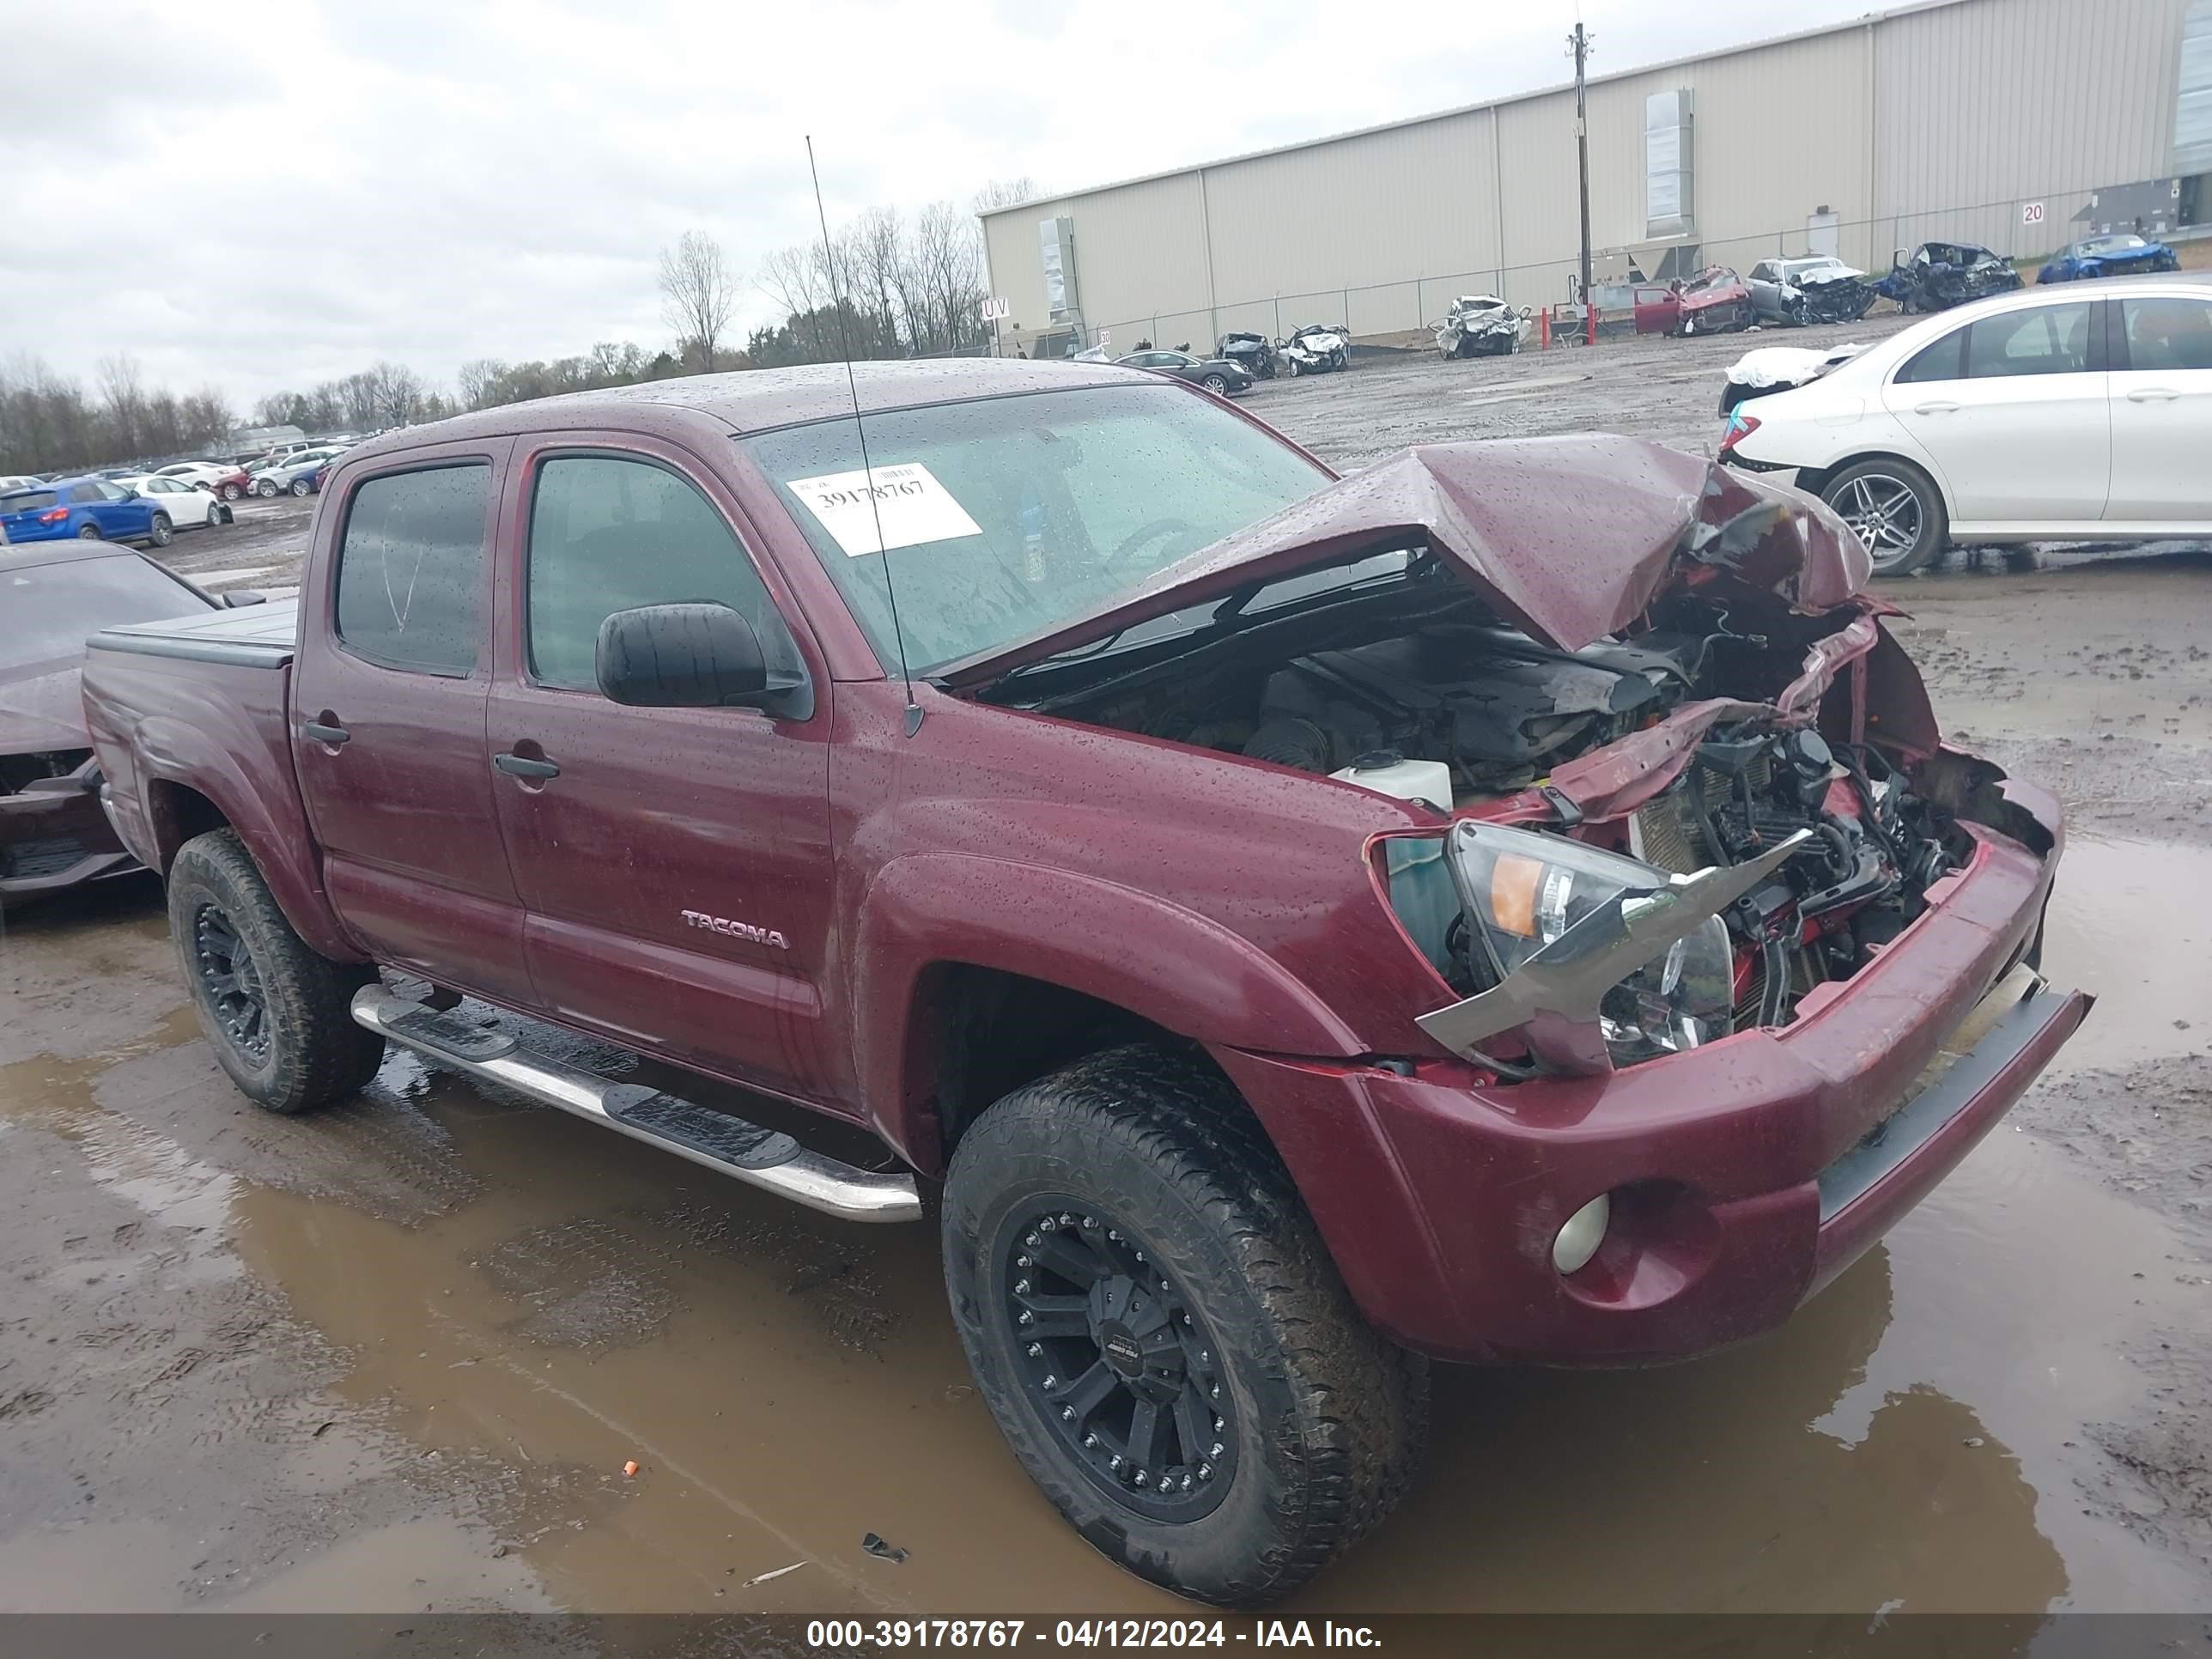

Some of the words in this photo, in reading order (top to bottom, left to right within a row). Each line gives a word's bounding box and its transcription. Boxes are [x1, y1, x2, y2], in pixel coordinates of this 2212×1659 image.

[2025, 205, 2042, 222] 20
[1101, 332, 1110, 343] 30
[817, 480, 924, 508] 39178767
[681, 909, 791, 950] TACOMA
